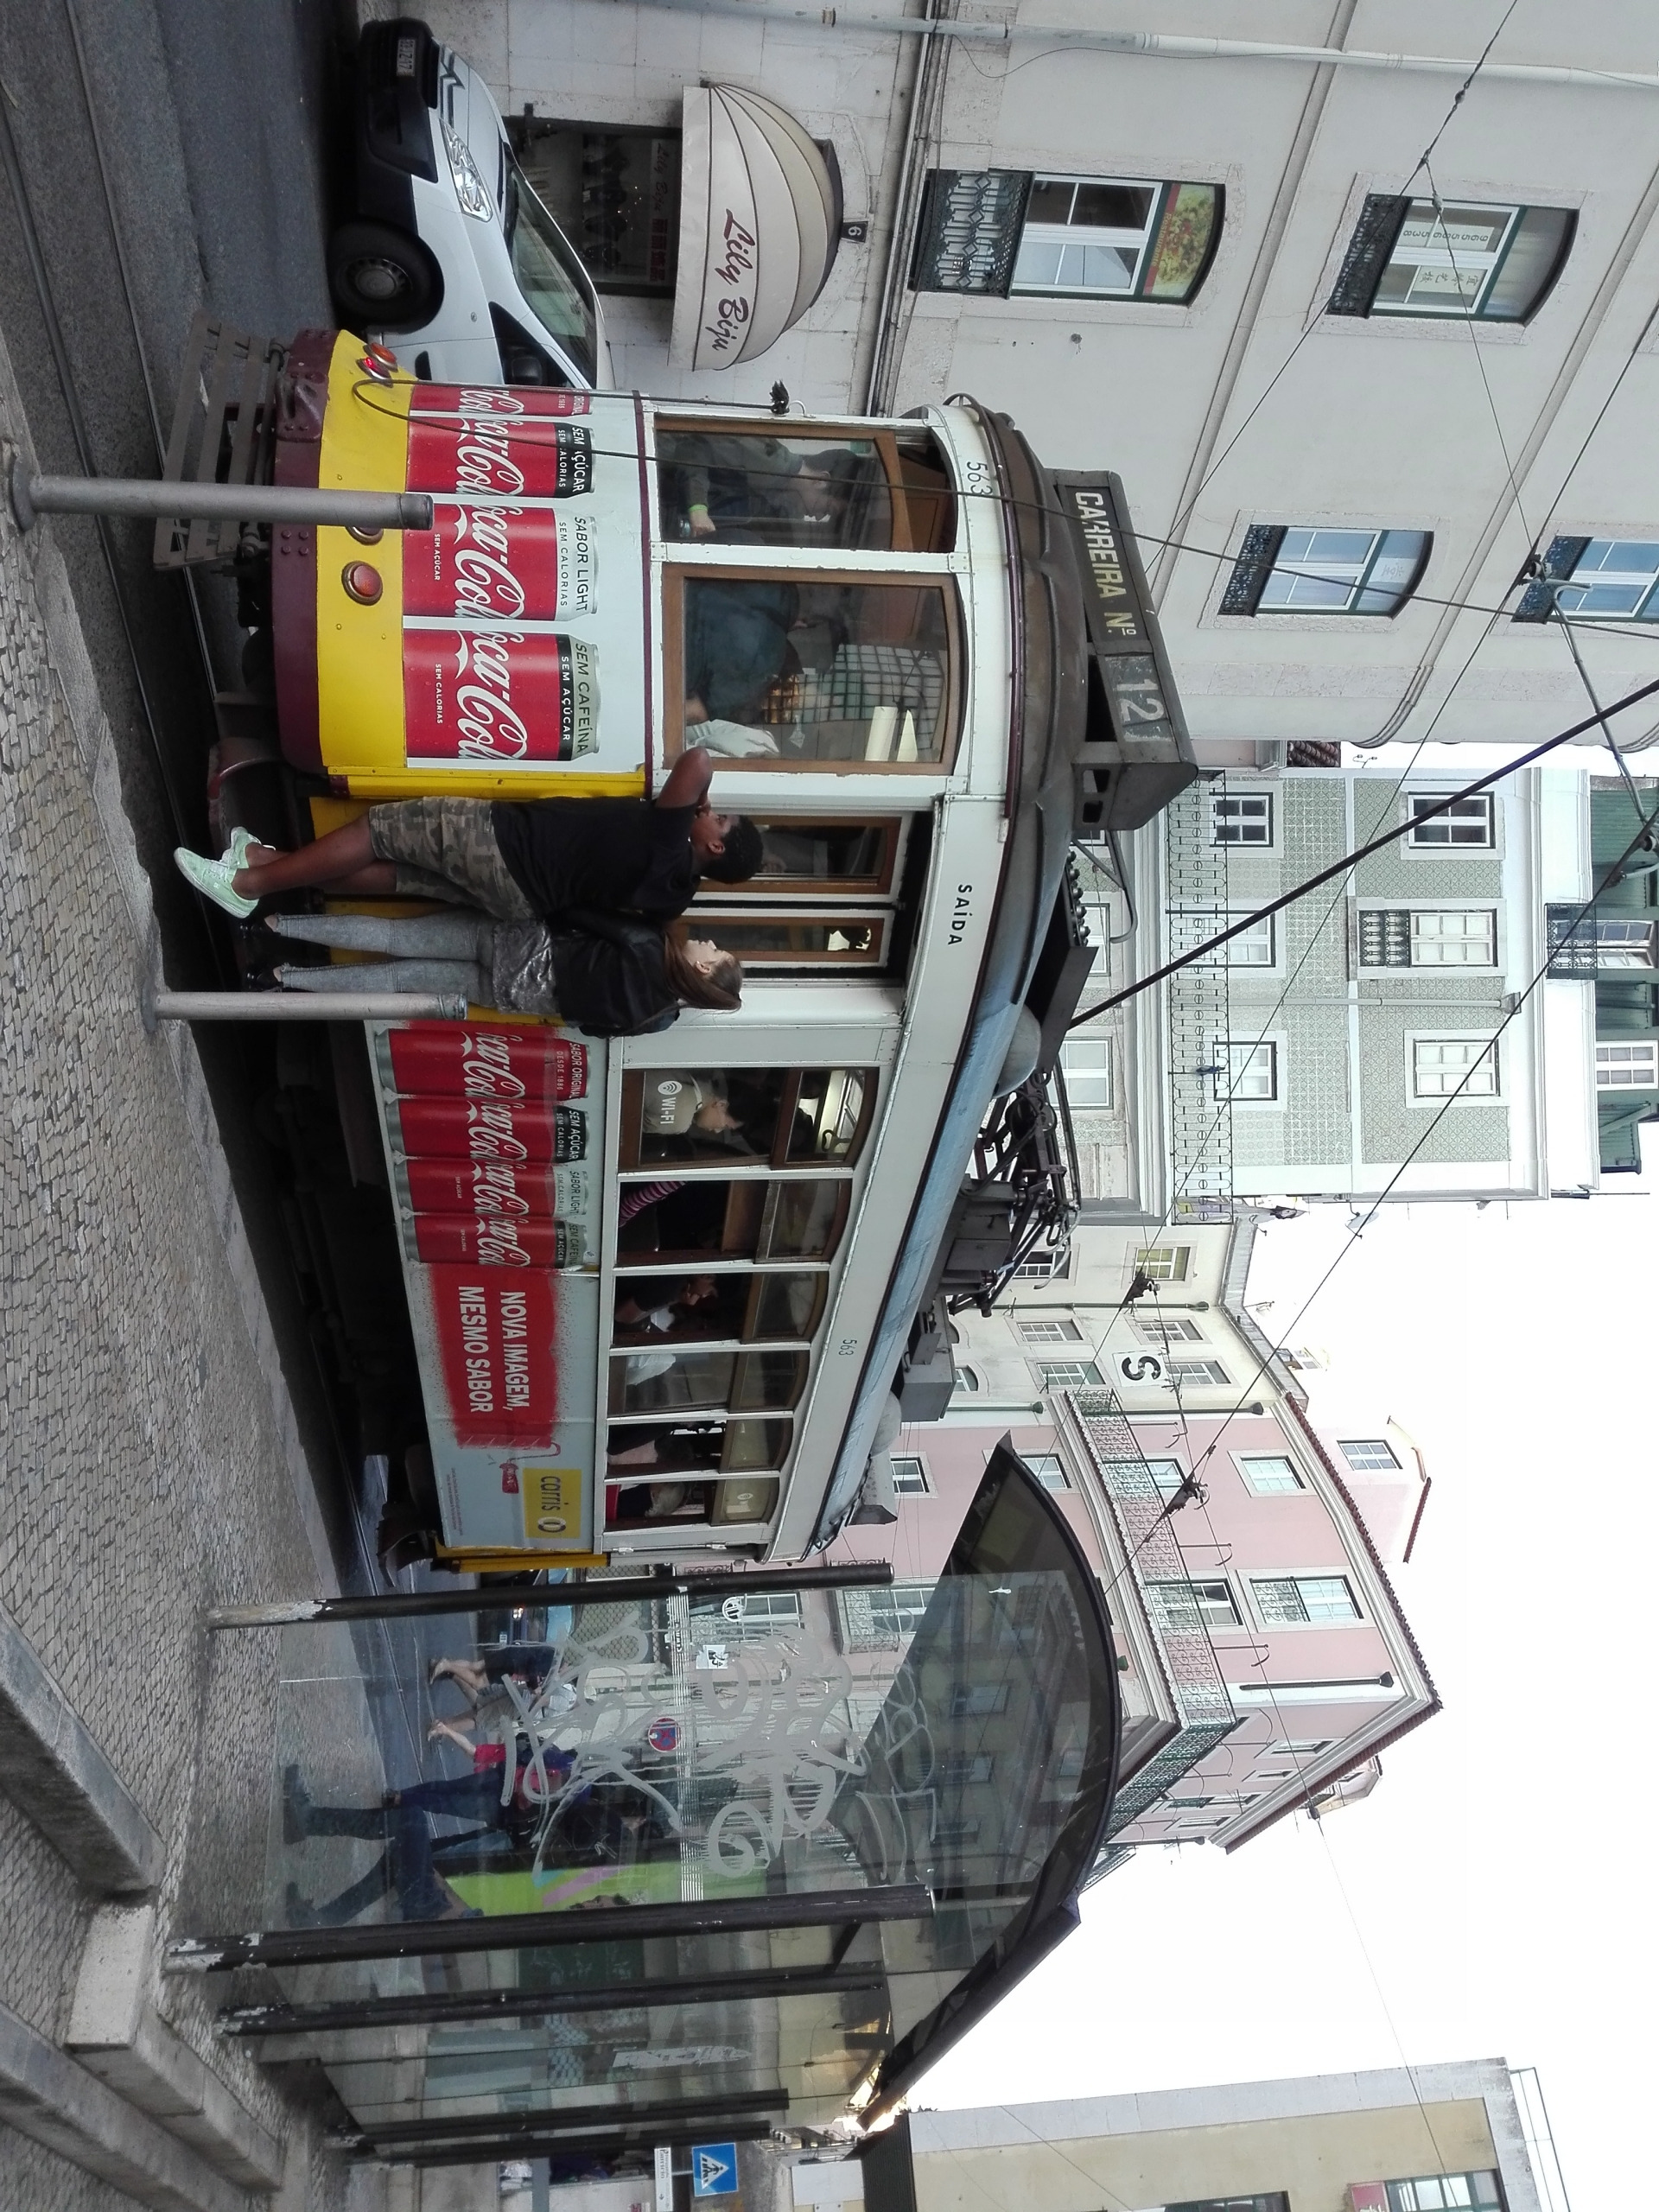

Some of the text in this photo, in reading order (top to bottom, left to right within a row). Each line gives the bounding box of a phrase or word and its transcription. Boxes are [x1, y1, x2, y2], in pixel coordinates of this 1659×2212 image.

[654, 143, 670, 175] Lily
[848, 226, 861, 237] 6
[1151, 212, 1173, 267] Restaurante
[705, 208, 755, 351] Lily Biju
[557, 429, 568, 487] SEM ALORIAS
[572, 427, 585, 445] SEM
[966, 461, 993, 496] 563
[433, 550, 442, 581] AÇÚCAR
[559, 521, 569, 607] SEM CALORIAS
[574, 517, 588, 613] SABOR LIGHT
[1075, 492, 1127, 599] CARREIRA
[561, 656, 573, 741] SEM AÇÚCAR
[575, 643, 593, 754] SEM CAFEÍNA
[1116, 678, 1165, 722] 12
[948, 884, 973, 945] SAÍDA
[569, 1043, 582, 1099] SABOR ORIGINAL
[568, 1110, 583, 1160] SEM AÇÚCAR
[660, 1097, 677, 1124] WI-FI
[569, 1171, 581, 1215] SABOR LIGHT
[569, 1224, 579, 1237] SEM
[458, 1287, 493, 1413] MESMO SABOR
[500, 1291, 530, 1411] NOVA IMAGEM,
[838, 1339, 857, 1356] 563
[1122, 1356, 1161, 1382] S
[540, 1476, 569, 1510] carris
